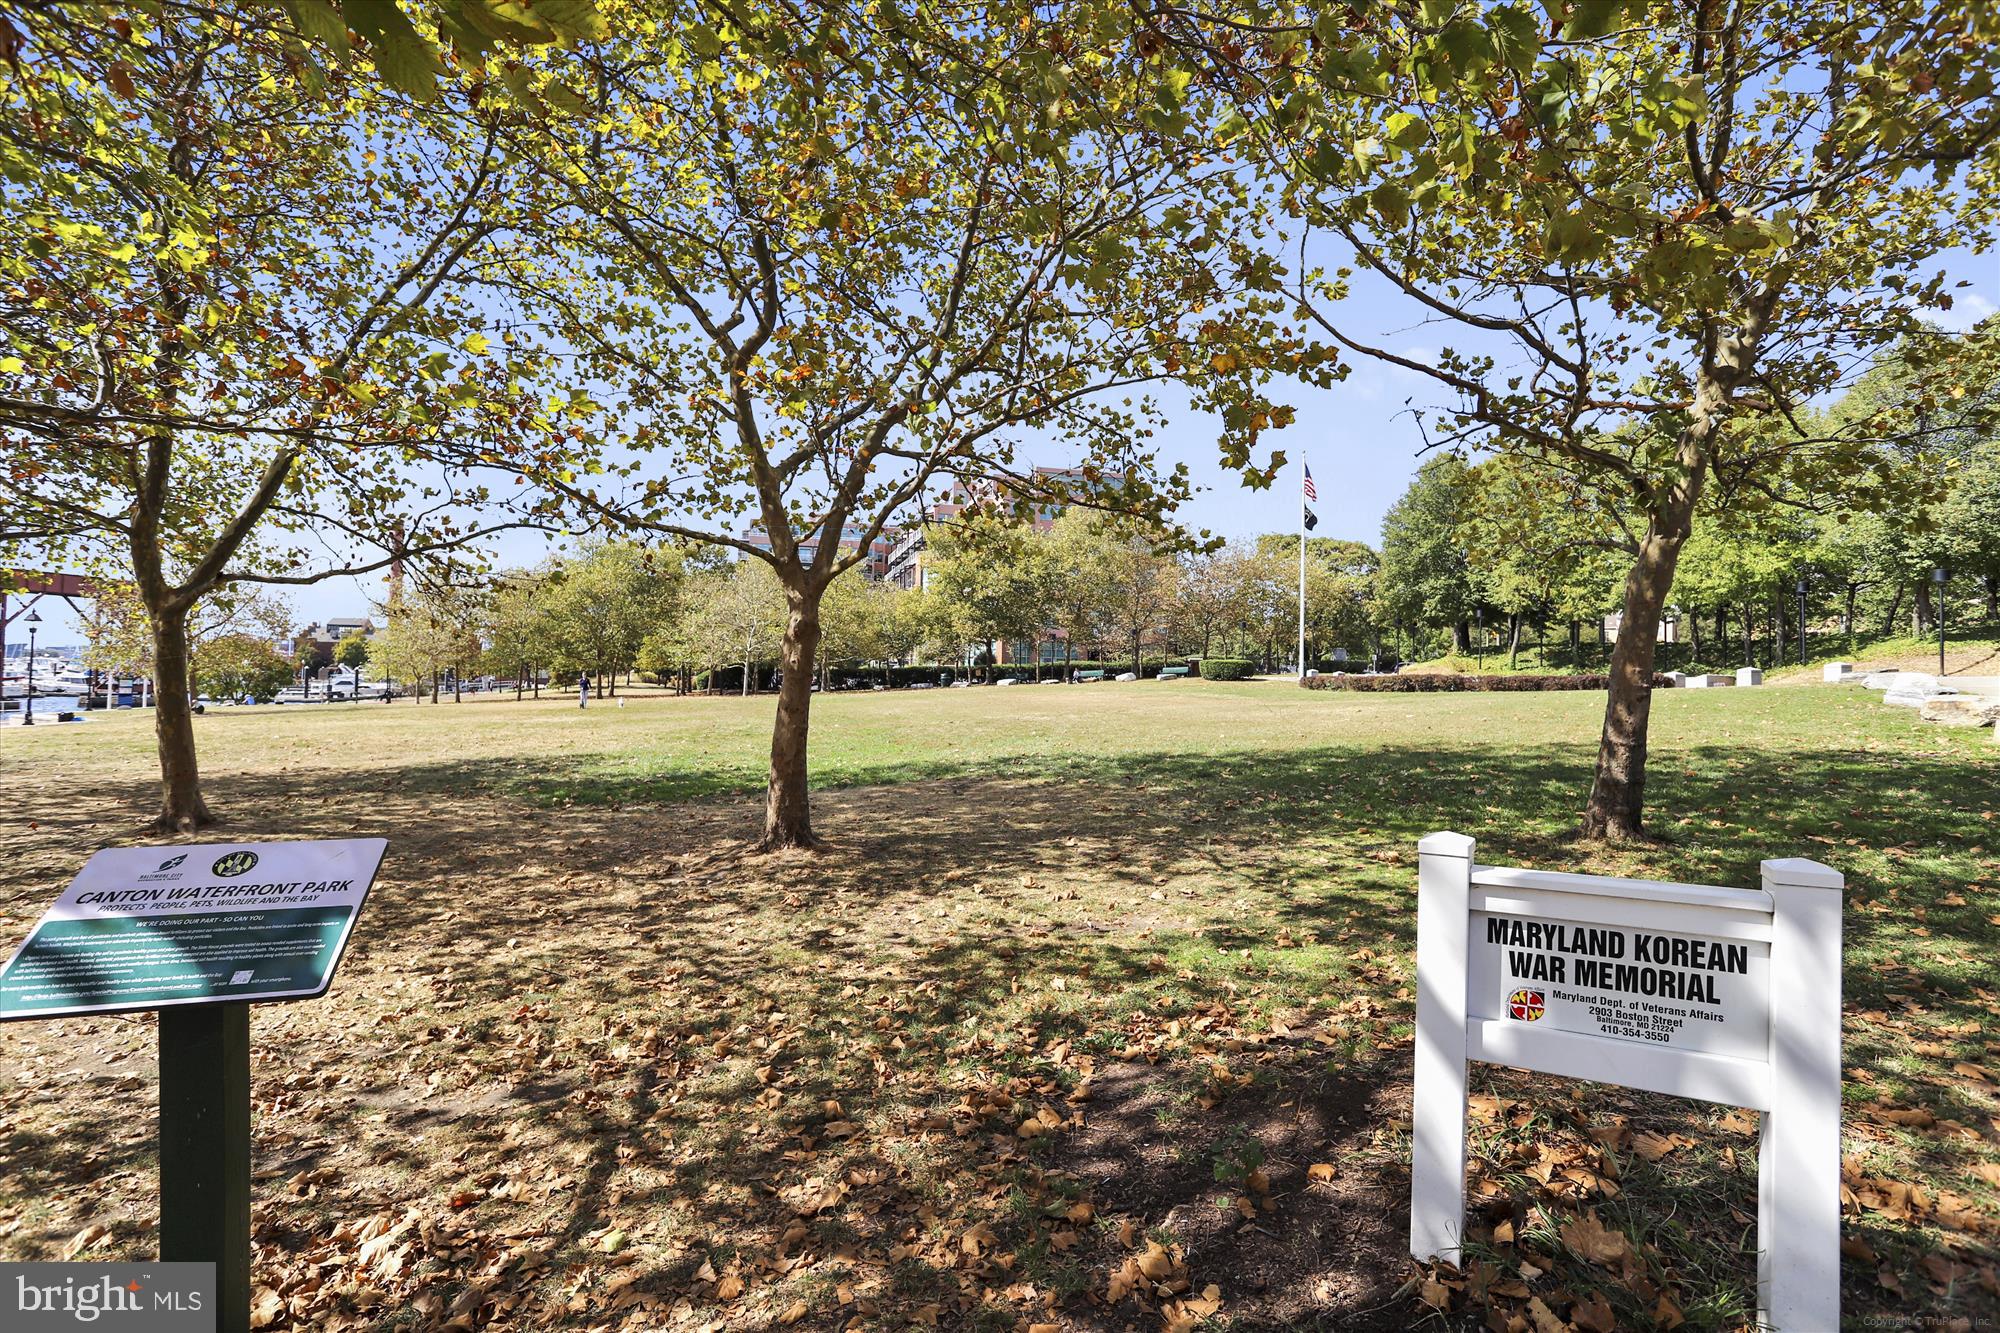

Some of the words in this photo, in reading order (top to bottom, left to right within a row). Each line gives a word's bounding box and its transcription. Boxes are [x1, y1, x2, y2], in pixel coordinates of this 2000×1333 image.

[76, 889, 165, 904] CANTON
[167, 882, 301, 899] WATERFRONT
[301, 879, 354, 894] PARK
[97, 903, 148, 912] PROTECTS
[150, 901, 187, 910] PEOPLE,
[189, 900, 214, 908] PETS,
[216, 898, 258, 907] WILDLIFE
[258, 896, 279, 904] AND
[281, 895, 298, 903] THE
[300, 894, 320, 902] BAY
[136, 920, 159, 928] WE'RE
[200, 917, 218, 925] PART
[1487, 917, 1625, 959] MARYLAND
[1634, 933, 1748, 975] KOREAN
[1508, 950, 1565, 984] WAR
[1575, 959, 1721, 1005] MEMORIAL
[1552, 989, 1597, 1005] Maryland
[1600, 996, 1626, 1010] Dept.
[1629, 1000, 1639, 1010] of
[1641, 1002, 1686, 1018] Veterans
[1689, 1008, 1724, 1022] Affairs
[1588, 1005, 1613, 1019] 2903
[1615, 1008, 1649, 1023] Boston
[1652, 1013, 1683, 1028] Street
[1600, 1024, 1670, 1043] 410-354-3550
[1637, 1021, 1649, 1029] MD
[1651, 1023, 1675, 1034] 21224
